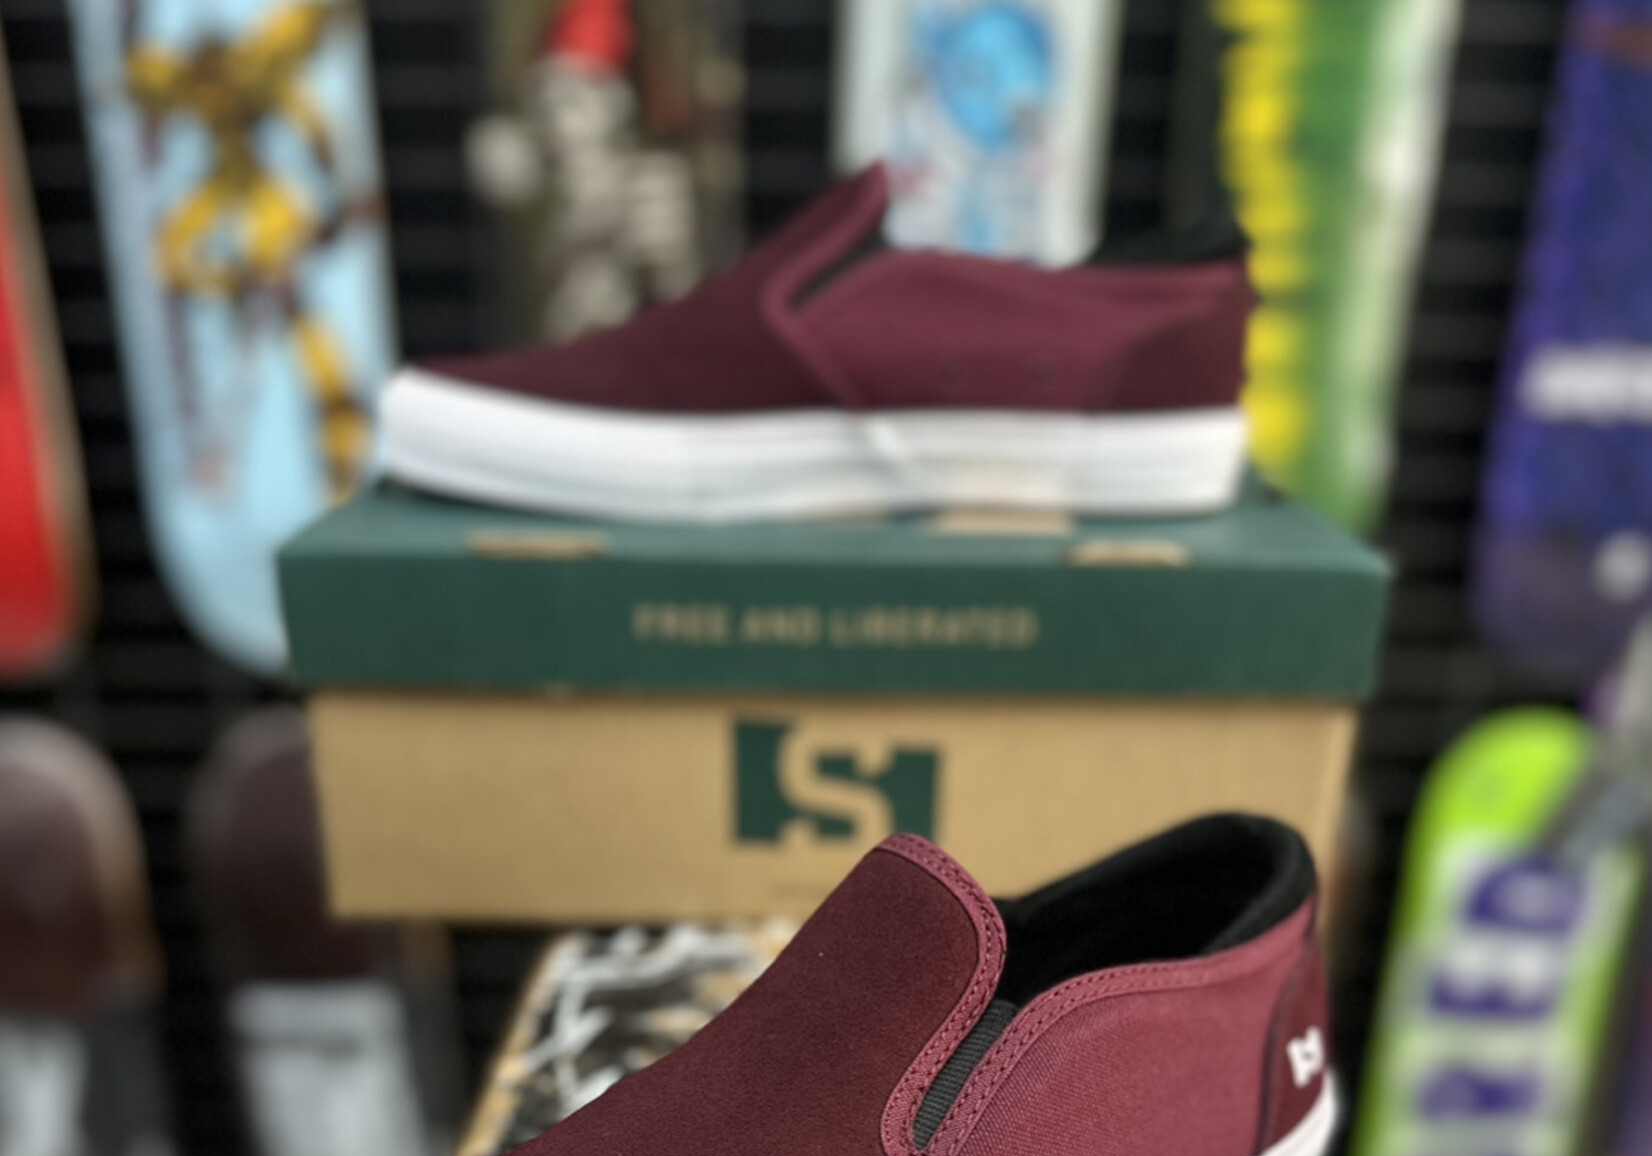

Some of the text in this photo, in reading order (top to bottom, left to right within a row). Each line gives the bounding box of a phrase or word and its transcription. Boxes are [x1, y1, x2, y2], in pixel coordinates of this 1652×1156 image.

[633, 602, 1039, 651] FREE AND LIBERATED
